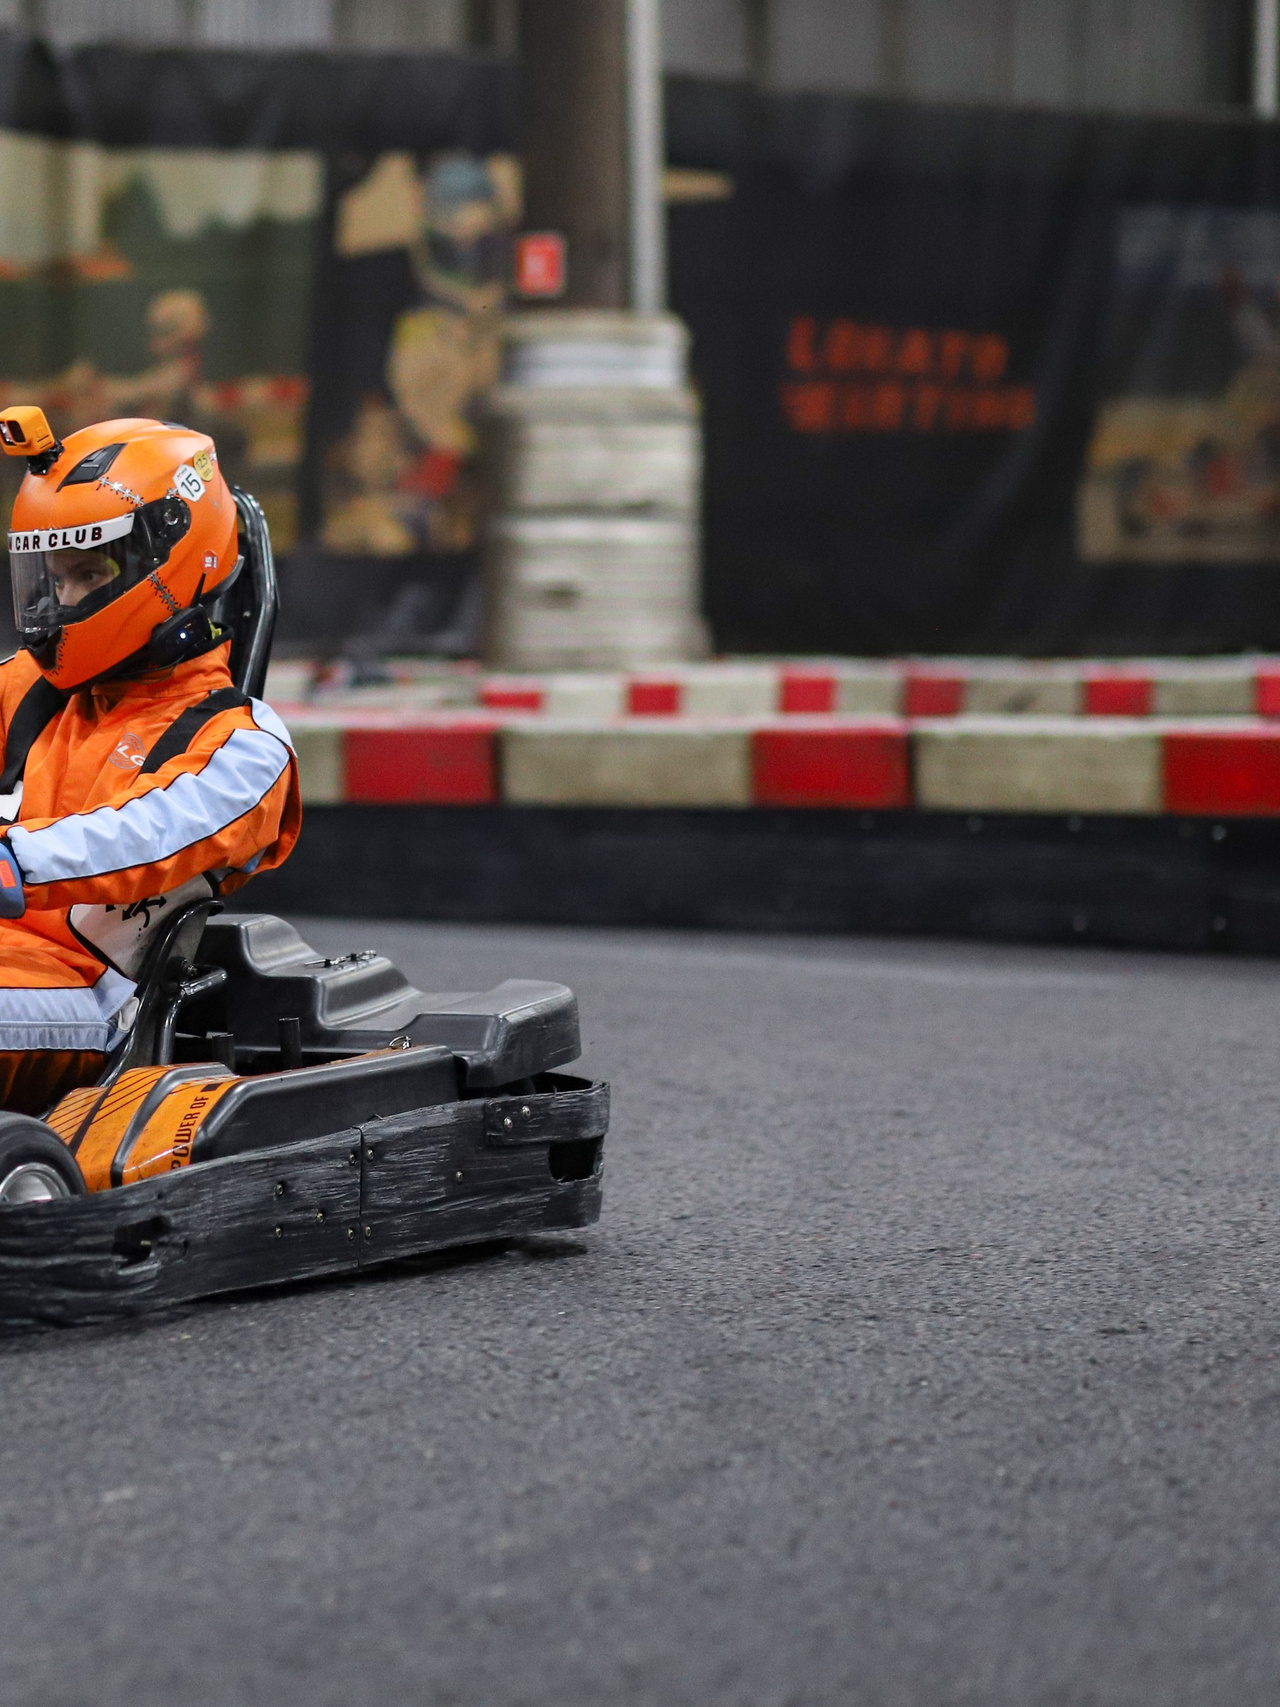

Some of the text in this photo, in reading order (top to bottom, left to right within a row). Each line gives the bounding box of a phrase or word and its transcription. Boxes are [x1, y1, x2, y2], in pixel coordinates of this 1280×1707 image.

[180, 473, 201, 498] 15
[15, 535, 40, 551] CAR
[48, 527, 103, 548] CLUB
[115, 742, 146, 767] LG
[170, 1096, 210, 1169] POWER OF
